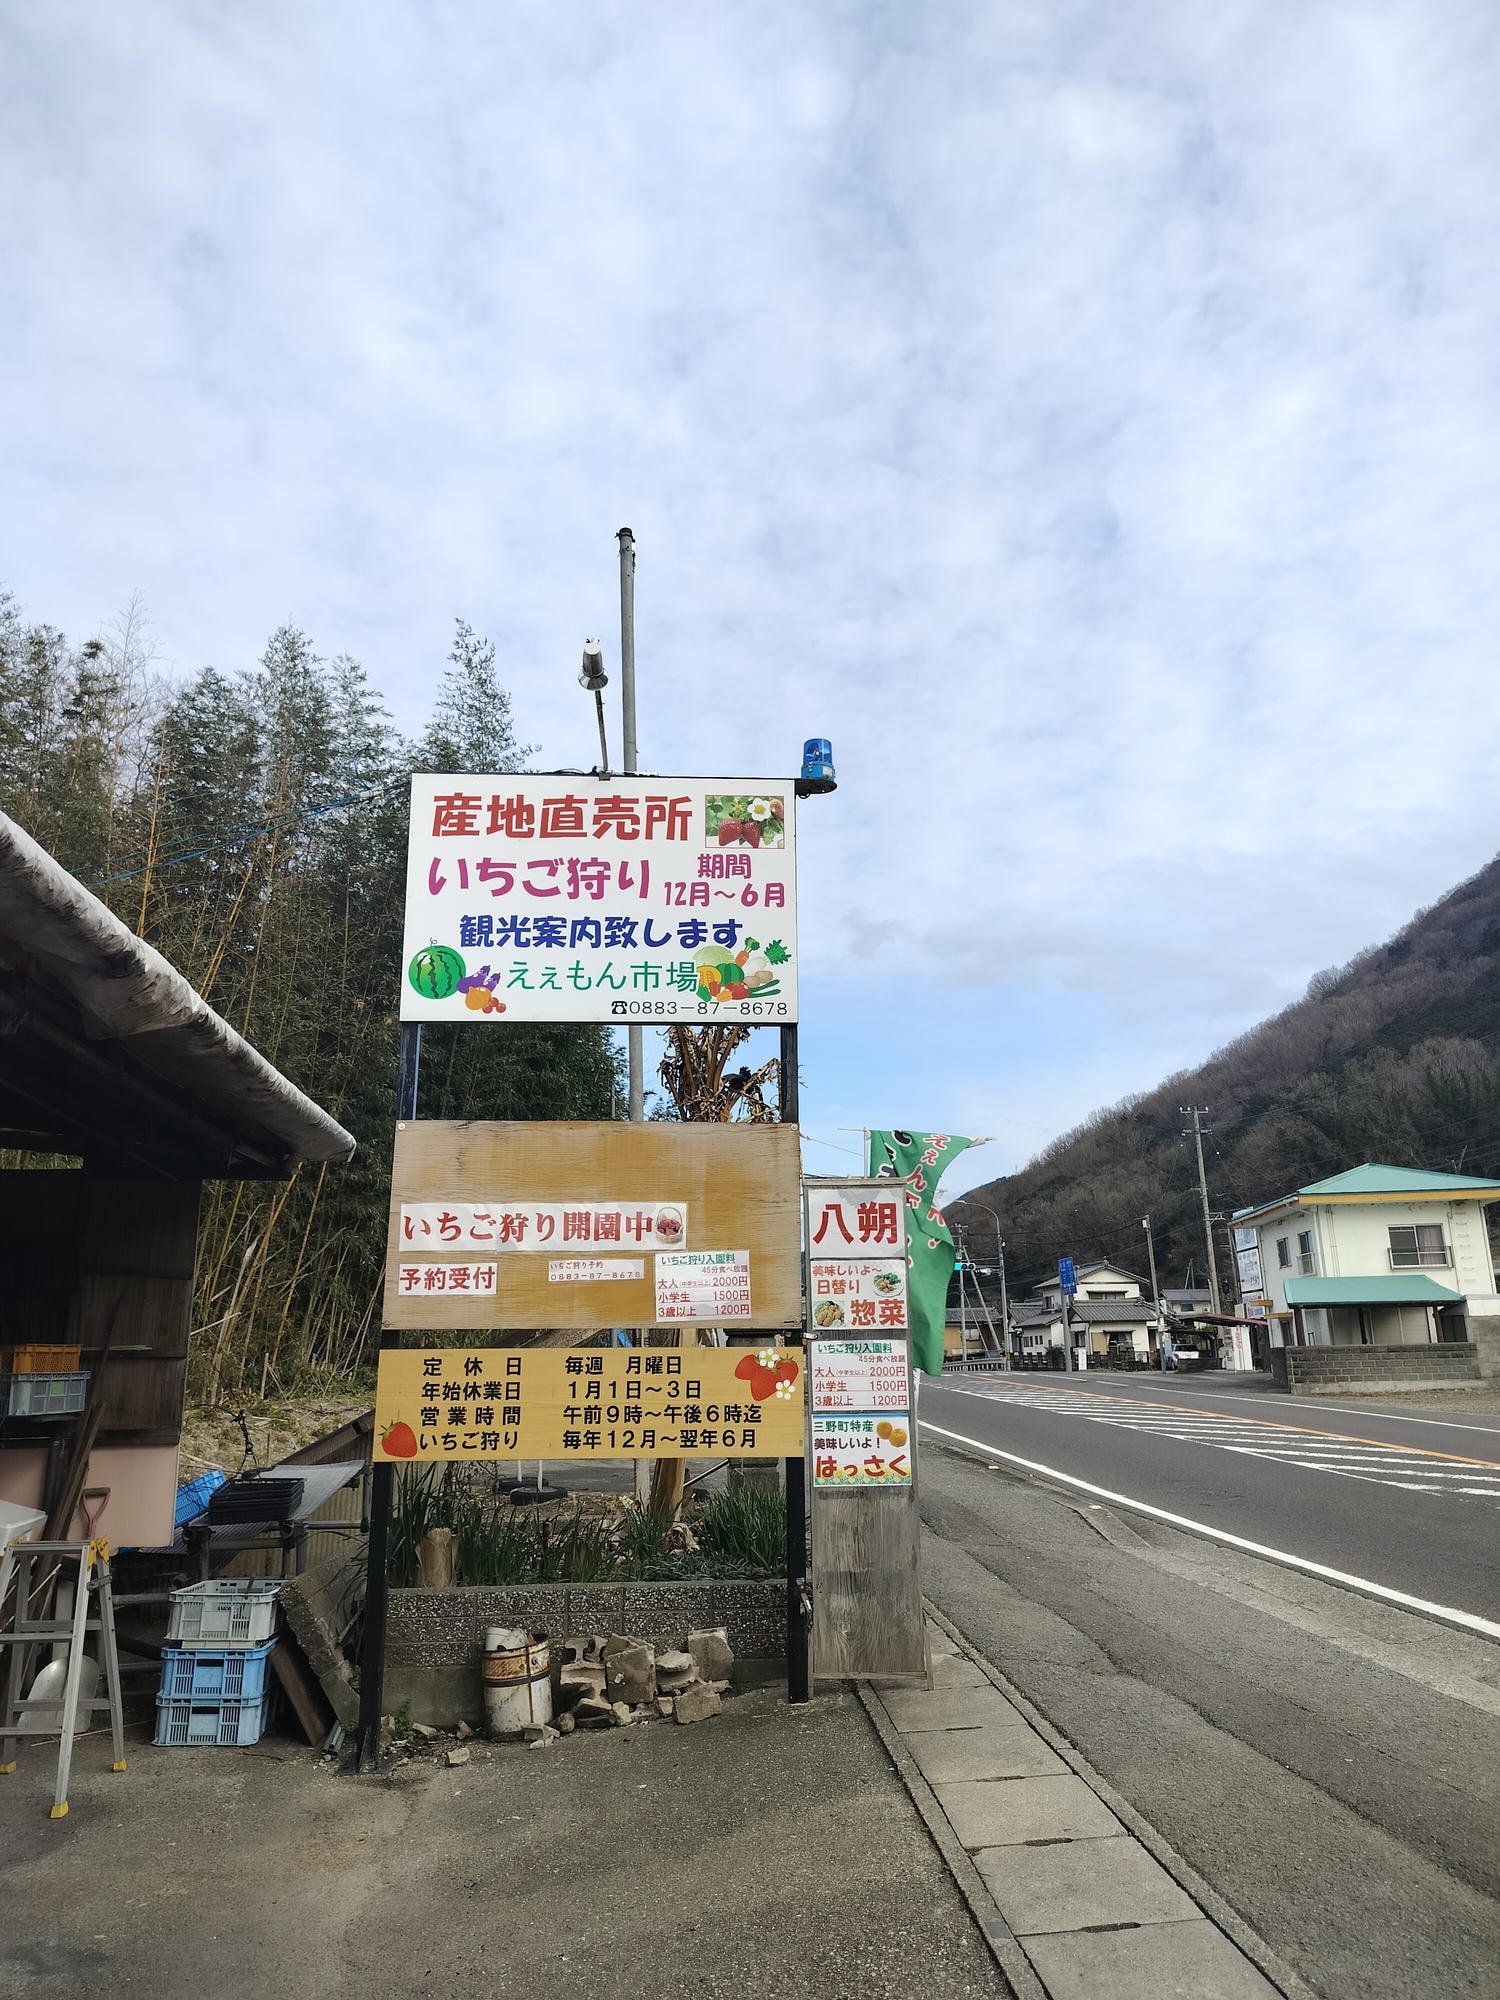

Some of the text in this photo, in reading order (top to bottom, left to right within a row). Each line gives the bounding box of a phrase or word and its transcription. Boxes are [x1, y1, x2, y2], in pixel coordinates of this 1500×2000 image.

[431, 792, 693, 841] 産地直売所
[697, 853, 752, 880] 期間
[428, 856, 650, 900] いちご狩り
[459, 914, 744, 949] 観光案内致します
[506, 960, 698, 993] えぇもん市場
[403, 1211, 653, 1243] いちご狩り開園中
[812, 1202, 899, 1245] 八朔
[550, 1261, 604, 1270] いちご狩り予約
[661, 1253, 735, 1265] いちご狩り入園料
[702, 1265, 748, 1274] 45分食べ放題
[399, 1266, 496, 1292] 予約受付
[658, 1278, 679, 1289] 大人
[713, 1276, 748, 1287] 2000円
[817, 1279, 860, 1294] 日替り
[658, 1290, 749, 1303] 小学生 1500円
[658, 1304, 750, 1317] 3歳以上 1200円
[850, 1299, 905, 1326] 惣菜
[817, 1343, 892, 1353] いちご狩り入園料
[858, 1355, 905, 1363] 45分食べ放題
[814, 1366, 835, 1377] 大人
[870, 1366, 906, 1376] 2000円
[421, 1381, 521, 1401] 年始休業日
[815, 1380, 907, 1392] 小学生 1500円
[815, 1395, 907, 1406] 3歳以上 1200円
[420, 1406, 521, 1426] 営業時間
[813, 1420, 874, 1432] 三野町特産
[419, 1431, 519, 1450] いちご狩り
[816, 1454, 908, 1478] はっさく
